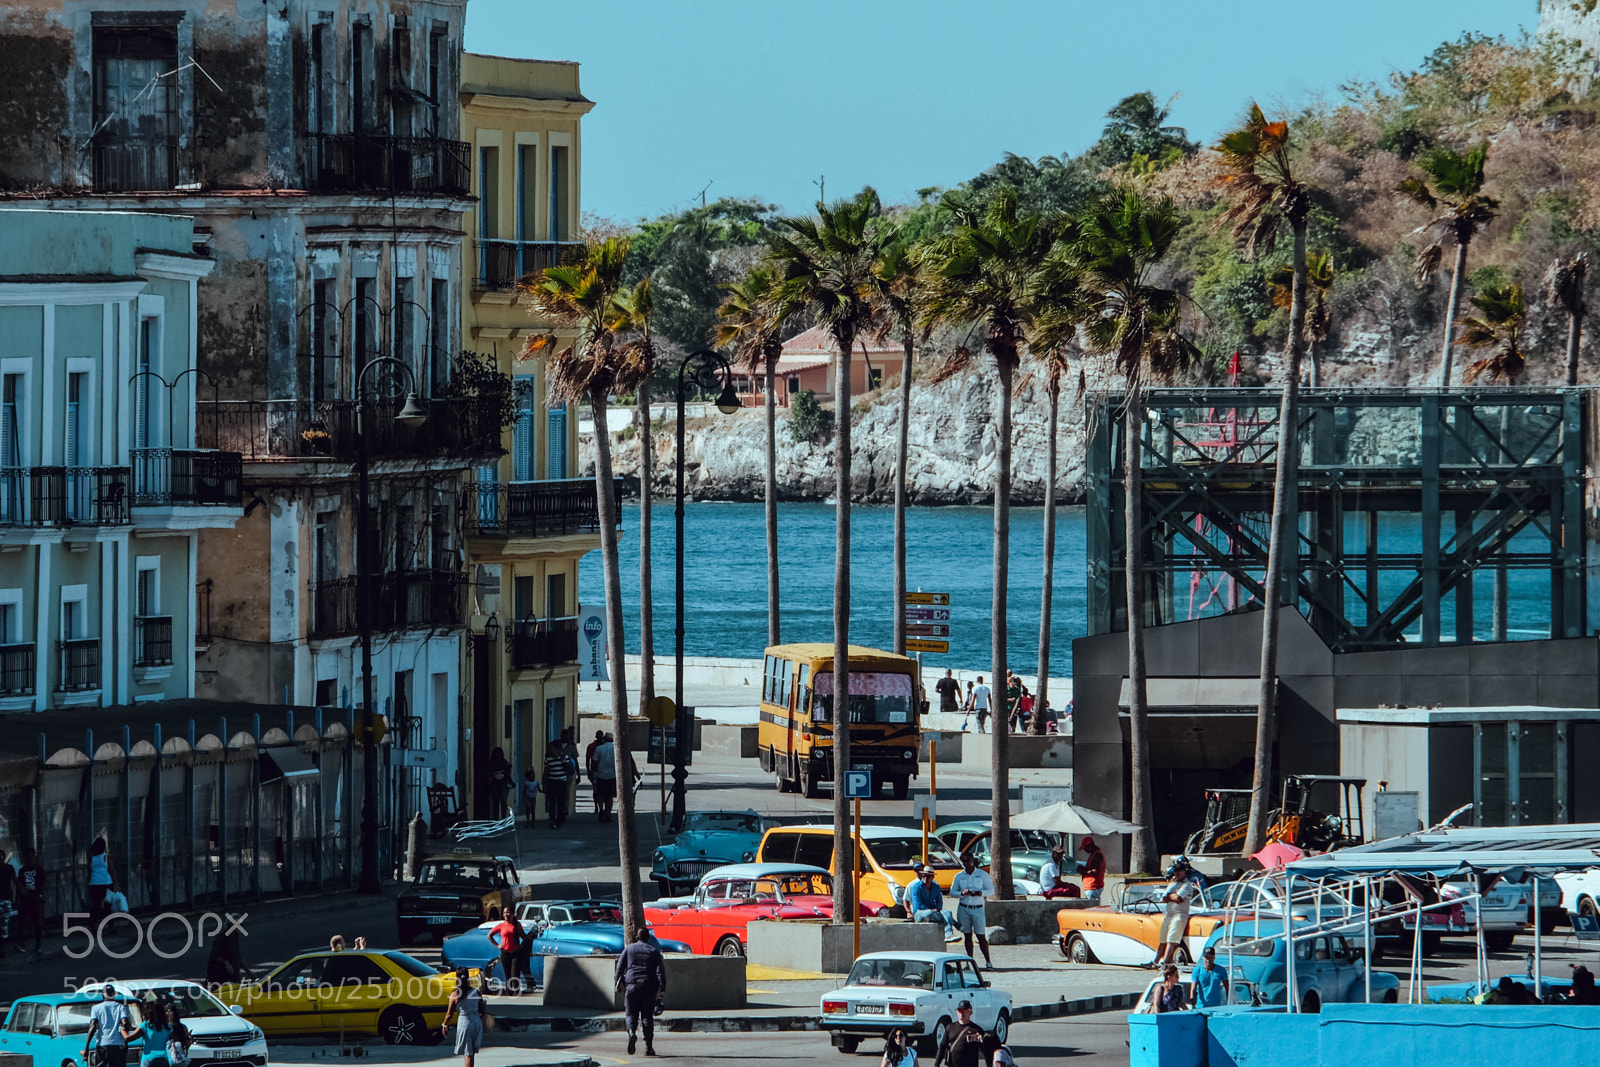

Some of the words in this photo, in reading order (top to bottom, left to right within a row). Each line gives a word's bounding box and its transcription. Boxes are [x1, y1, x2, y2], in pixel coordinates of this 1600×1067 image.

[585, 621, 602, 631] info
[590, 639, 598, 677] habana
[848, 773, 868, 796] P
[1577, 917, 1591, 931] P
